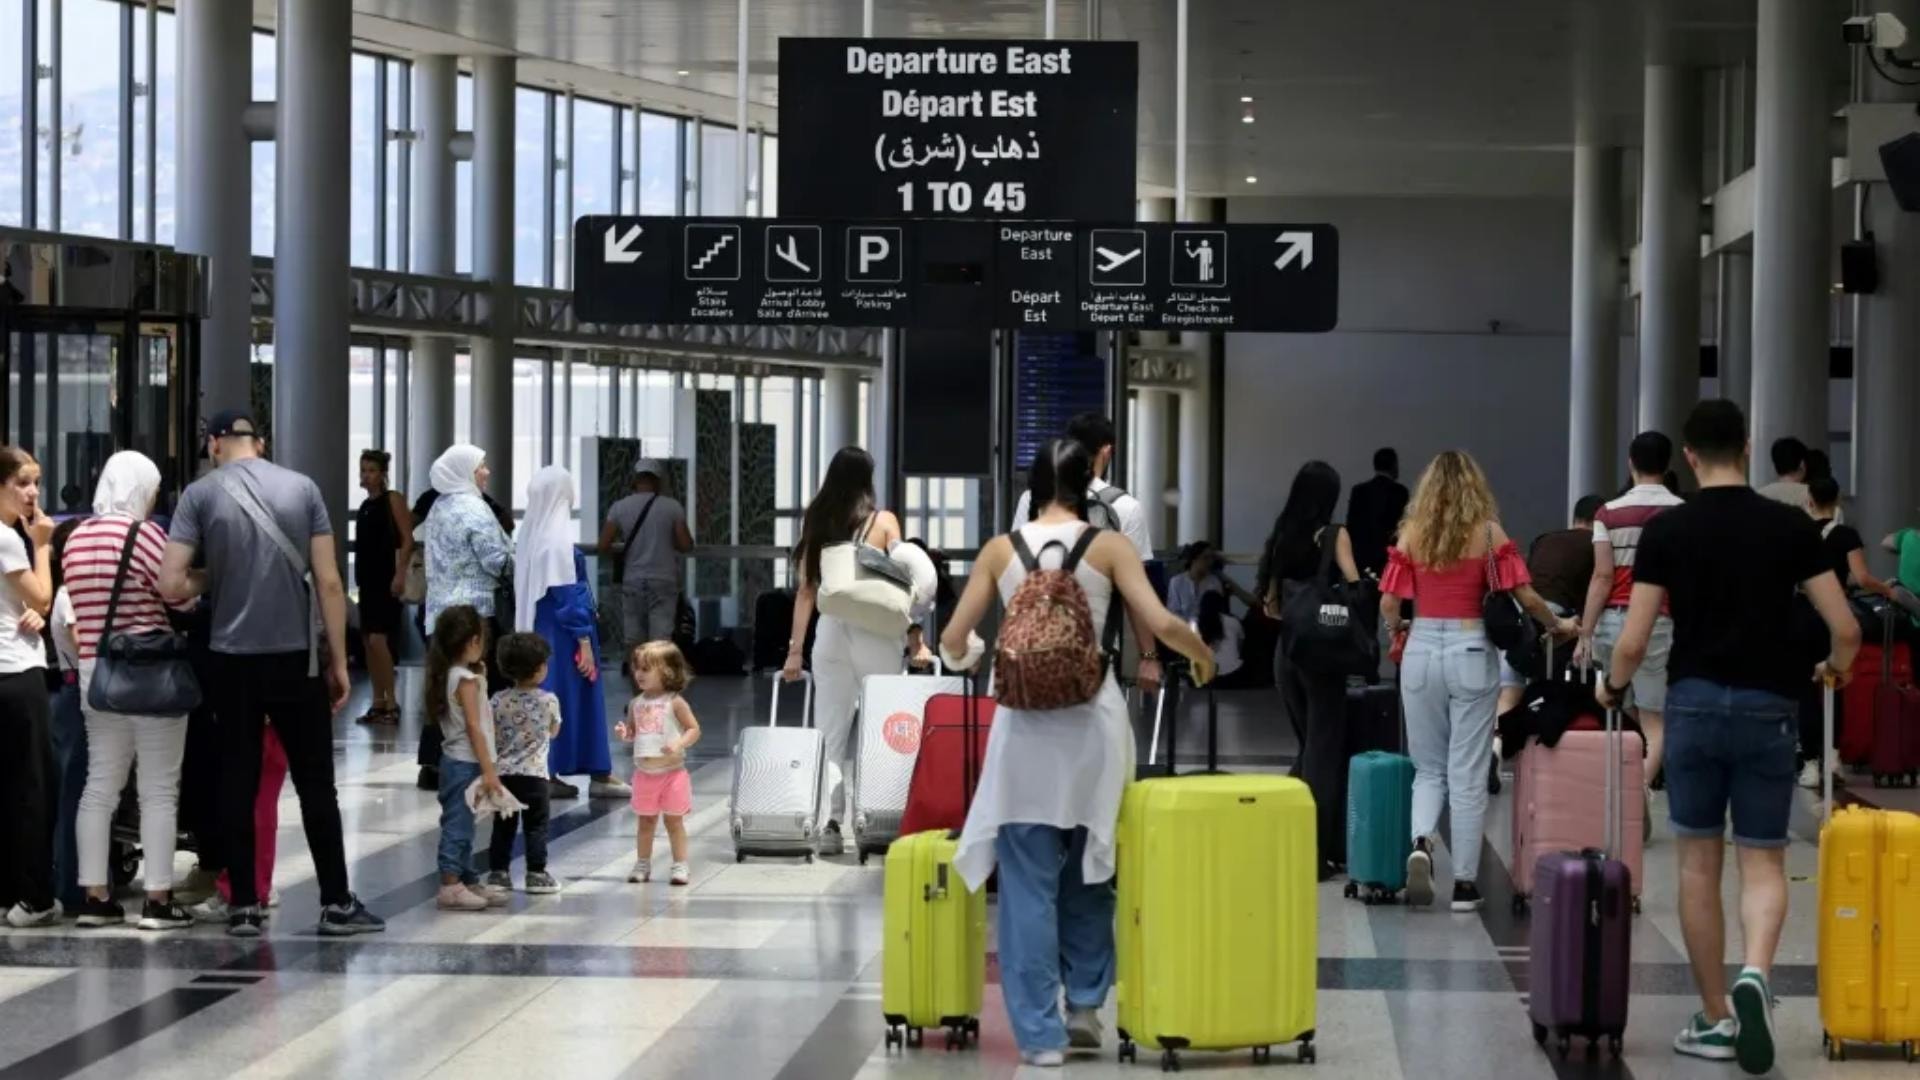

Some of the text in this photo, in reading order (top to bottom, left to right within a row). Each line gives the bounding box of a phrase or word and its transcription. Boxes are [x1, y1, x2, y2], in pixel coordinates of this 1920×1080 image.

[847, 47, 1071, 79] Departure East
[883, 90, 1037, 122] Départ Est
[875, 131, 1039, 171] ذهاب (شرق)
[898, 182, 1026, 212] 1 TO 45
[1001, 228, 1072, 242] Departure
[1021, 247, 1052, 260] East
[877, 290, 906, 299] مواقف
[1012, 290, 1060, 305] Départ
[699, 297, 726, 306] Stairs
[761, 297, 825, 308] Arrival Lobby
[856, 300, 891, 310] Parking
[1080, 301, 1130, 312] Departure
[691, 308, 733, 317] Escaliers
[757, 309, 782, 318] Salle
[1025, 309, 1046, 322] Est
[1091, 312, 1144, 323] Départ Est
[1162, 313, 1234, 325] Enregistrement
